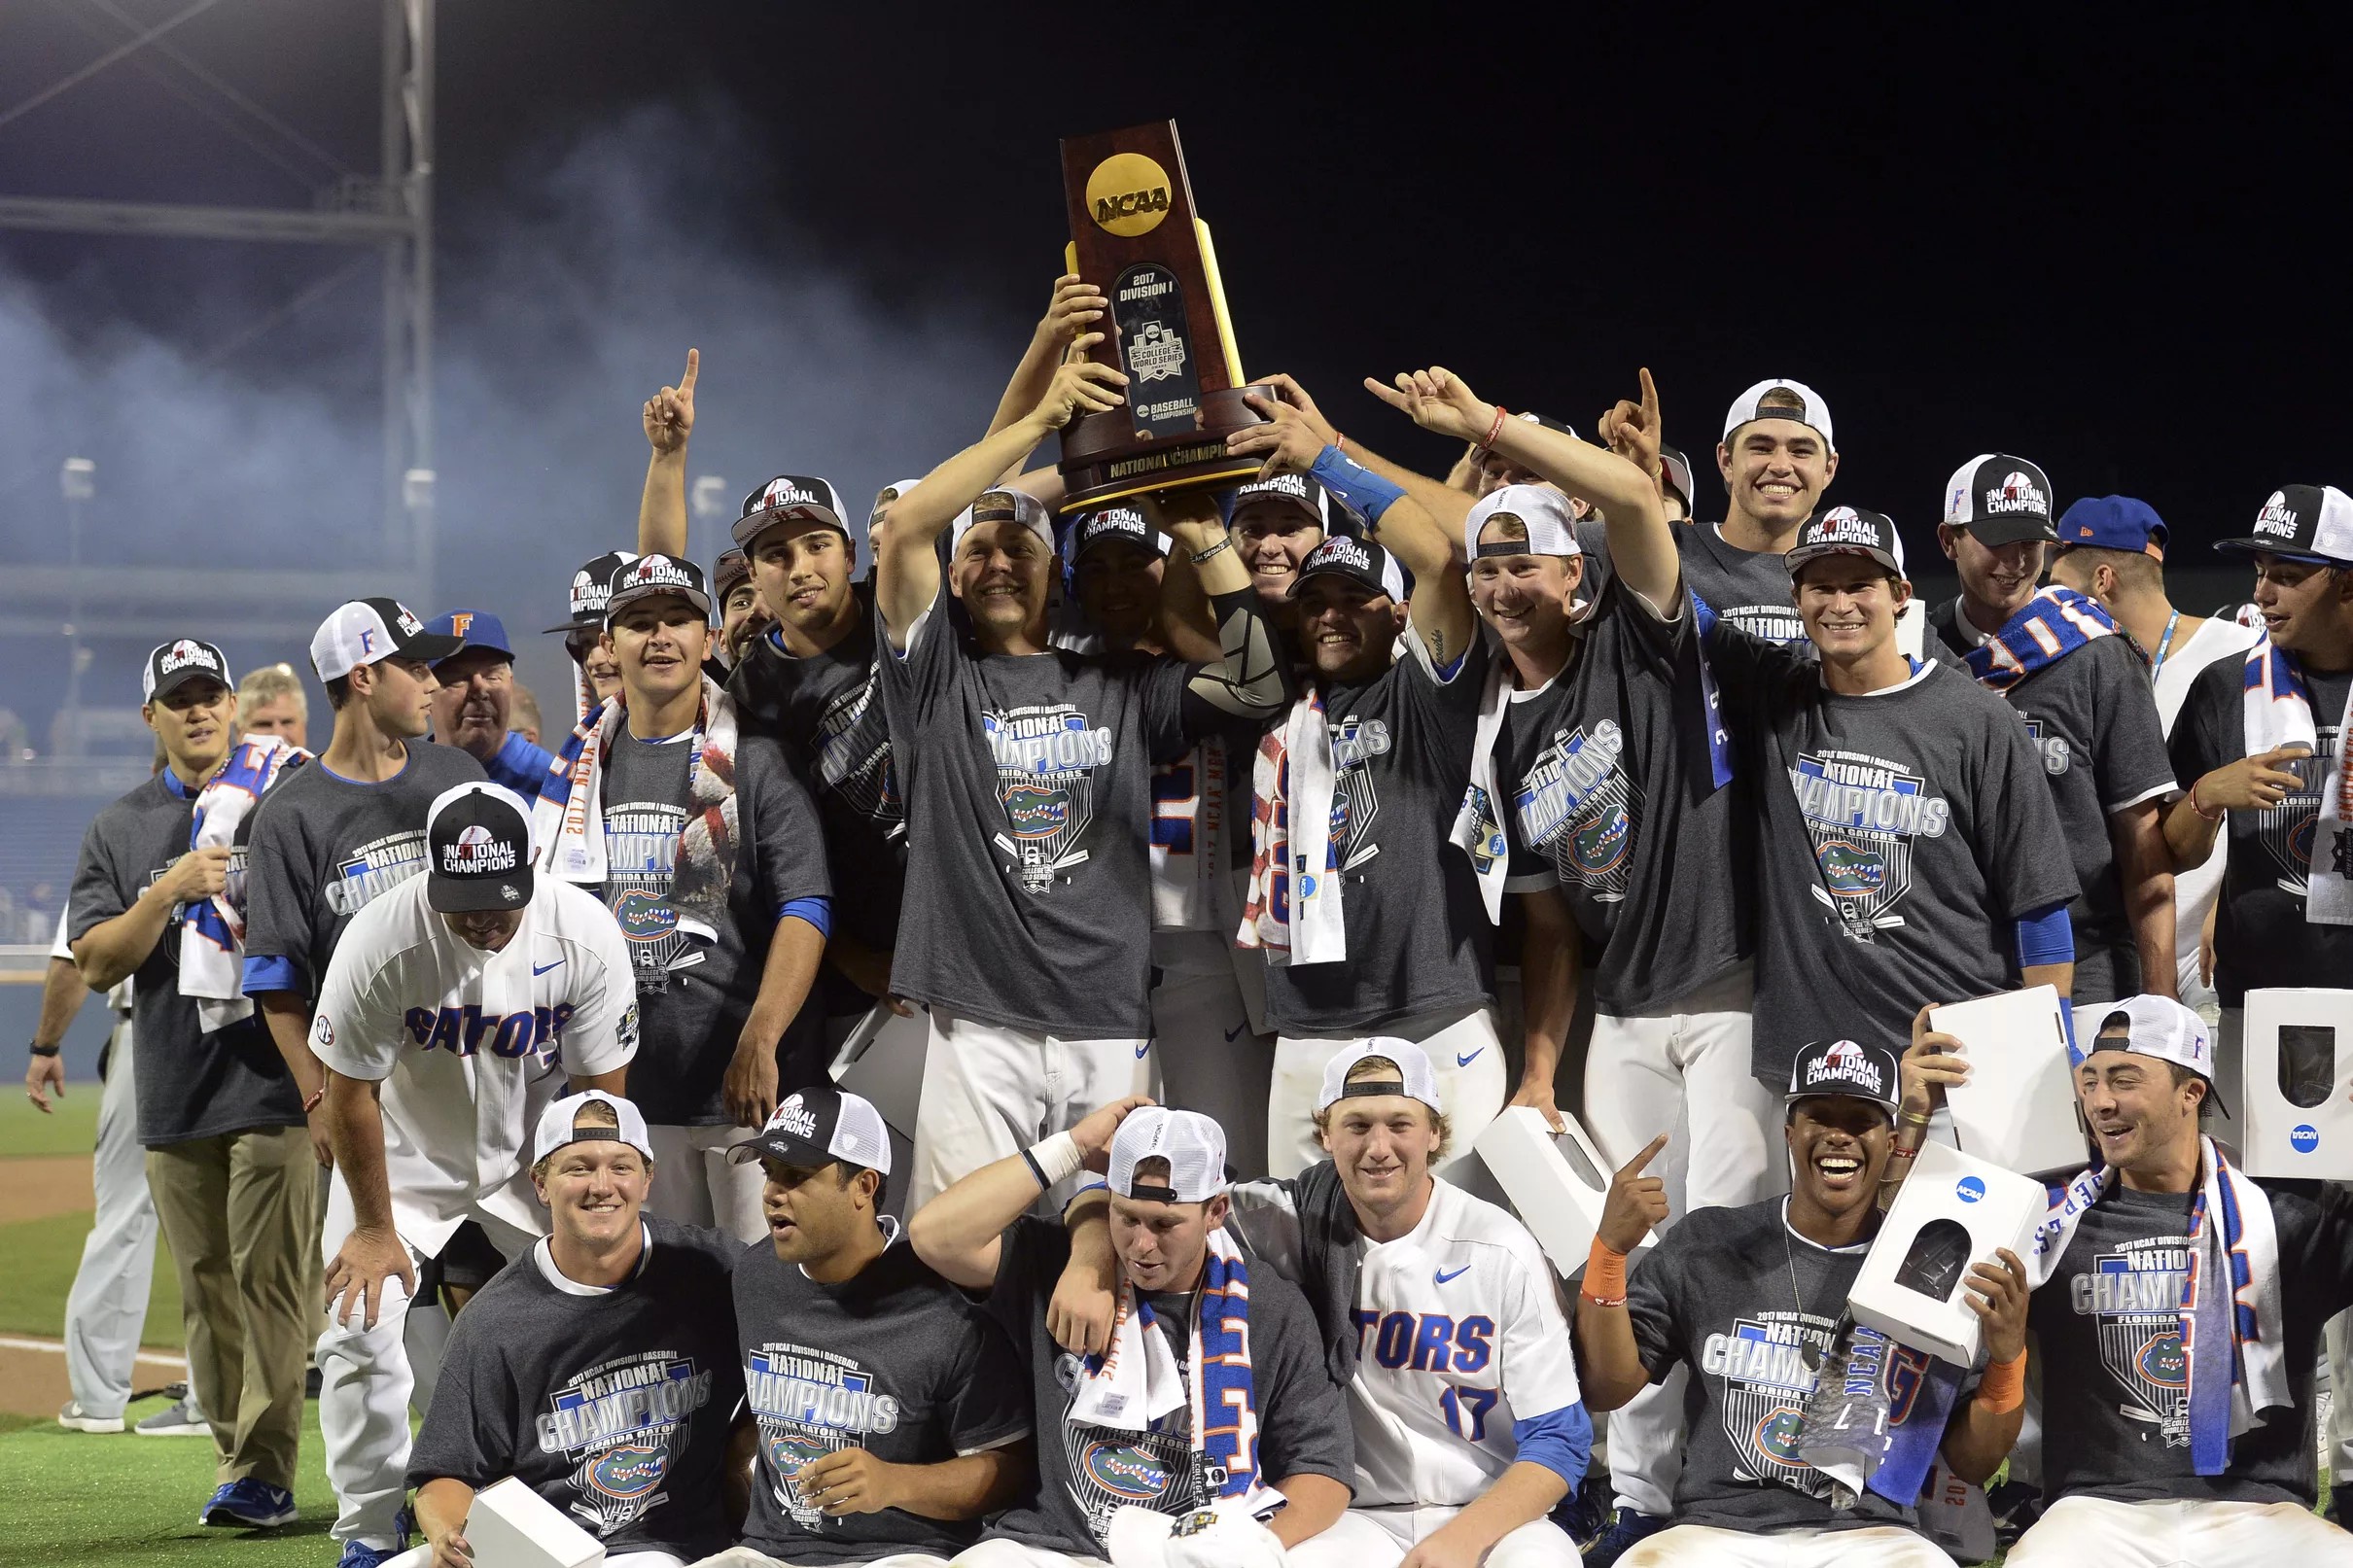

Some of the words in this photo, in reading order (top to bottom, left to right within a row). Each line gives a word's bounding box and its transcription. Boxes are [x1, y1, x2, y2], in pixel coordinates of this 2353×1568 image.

[1097, 187, 1170, 224] NCAA
[1134, 272, 1155, 287] 2017
[1119, 283, 1167, 302] DIVISION
[1168, 280, 1174, 294] I
[1133, 357, 1158, 370] WORLD
[1158, 352, 1183, 366] SERIES
[1141, 346, 1172, 360] COLLEGE
[1150, 398, 1194, 415] BASEBALL
[1151, 407, 1197, 423] CHAMPIONSHIP
[1110, 452, 1170, 479] NATIONAL
[1171, 443, 1228, 469] CHAMPIO
[1951, 488, 1965, 515] F
[1986, 499, 2048, 516] CHAMPIONS
[1084, 519, 1146, 540] CHAMPIONS
[1307, 552, 1371, 572] CHAMPIONS
[1721, 607, 1738, 618] 2017
[1739, 606, 1760, 616] NCAA
[1760, 606, 1792, 617] DIVISION
[452, 611, 474, 638] F
[1733, 616, 1809, 640] NATIONA
[360, 628, 374, 657] F
[161, 656, 219, 675] CHAMPIONS
[1008, 706, 1040, 719] DIVISION
[1044, 703, 1076, 715] BASEBALL
[2316, 725, 2340, 735] DIVISI
[574, 747, 596, 787] NCAA
[849, 741, 891, 781] FLORIDA
[1837, 751, 1871, 765] DIVISION
[1874, 757, 1911, 776] BASEBALL
[659, 803, 687, 817] BASEBA
[1787, 765, 1949, 840] HAMPIONS
[2276, 797, 2321, 806] FLORID
[566, 796, 586, 836] 2017
[610, 813, 682, 834] NATIONAL
[1806, 819, 1846, 835] LORIDA
[1539, 818, 1573, 847] FLORIDA
[352, 846, 369, 858] 2017
[386, 830, 414, 845] DIVISION
[365, 839, 429, 871] NATION
[443, 854, 515, 874] CHAMPIONS
[2193, 1033, 2205, 1061] F
[1806, 1067, 1882, 1095] CHAMPIONS
[2292, 1131, 2318, 1141] NCAA
[1956, 1183, 1984, 1201] NCAA
[2115, 1240, 2133, 1254] 2017
[2133, 1237, 2156, 1250] NCAA
[2157, 1236, 2190, 1247] DIVISIO
[2126, 1249, 2190, 1272] NATIO
[1757, 1311, 1775, 1322] 2017
[1776, 1311, 1800, 1322] NCAA
[1799, 1312, 1836, 1329] DIVISION
[2117, 1314, 2178, 1324] FLORIDA
[1349, 1309, 1496, 1374] TORS
[1763, 1321, 1838, 1354] NATION
[762, 1342, 775, 1352] 2017
[790, 1344, 820, 1358] DIVISION
[824, 1352, 860, 1372] BASEBALL
[567, 1373, 584, 1389] 2017
[583, 1364, 606, 1379] NCAA
[605, 1355, 638, 1371] DIVISION
[643, 1349, 678, 1362] BASEBALL
[767, 1351, 845, 1387] NATIONAL
[579, 1360, 671, 1402] NATIONAL
[1744, 1382, 1802, 1401] FLORIDA
[743, 1365, 899, 1435] HAMPIONS
[536, 1369, 713, 1454] CHAMPIONS
[756, 1414, 797, 1431] FLORIDA
[1438, 1384, 1499, 1443] 17
[2171, 1418, 2190, 1427] COLLE
[584, 1434, 633, 1452] FLORIDA
